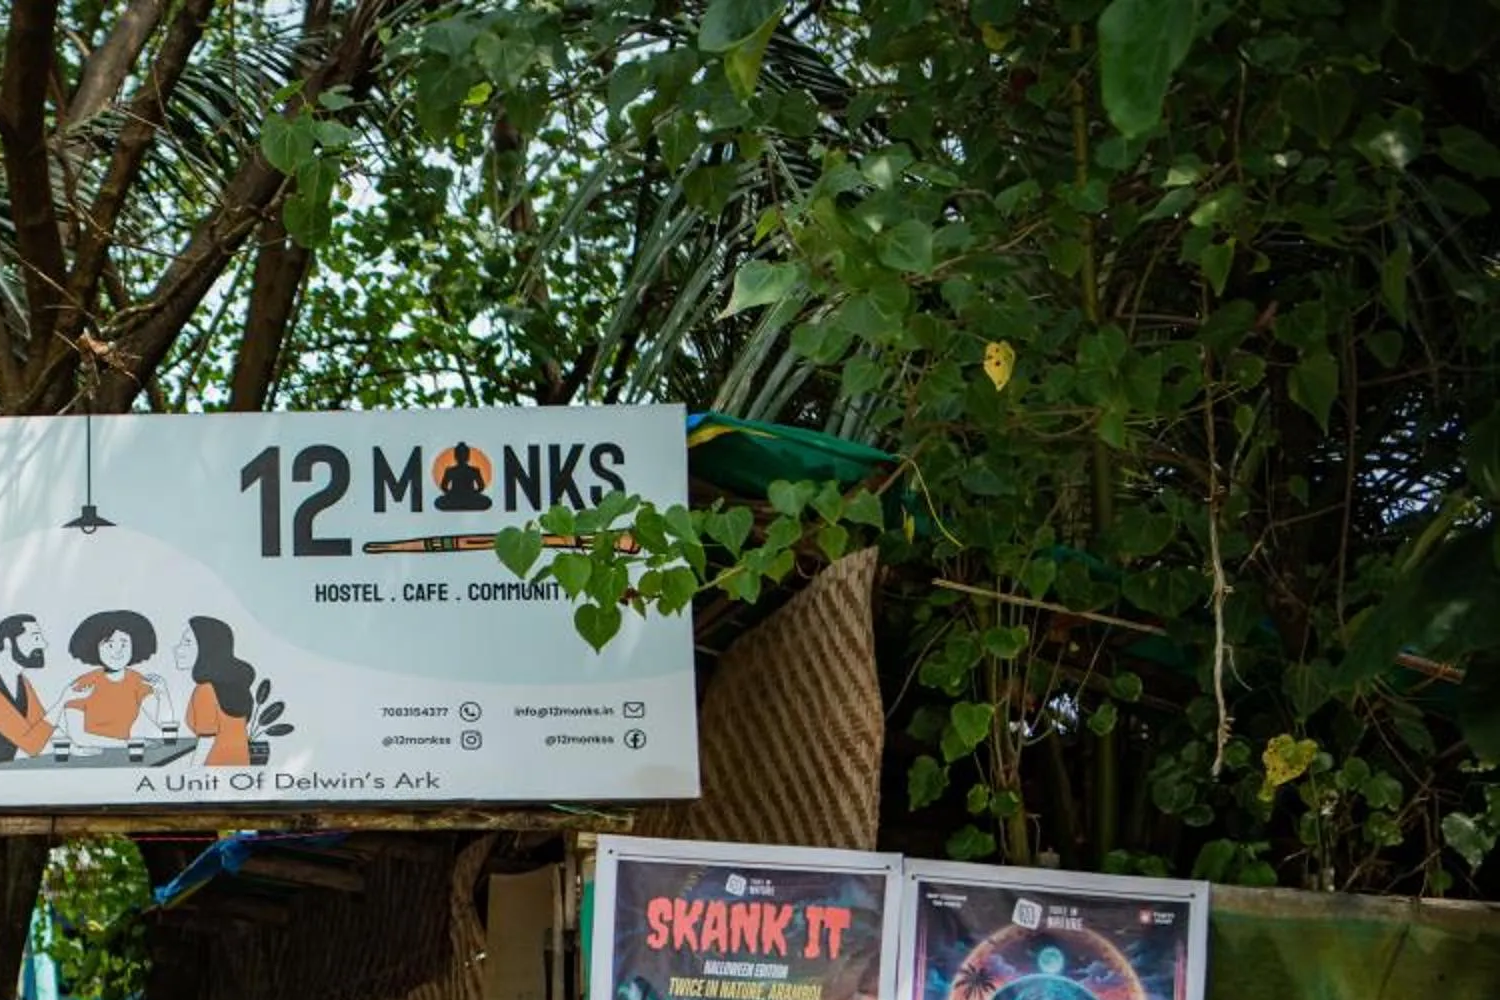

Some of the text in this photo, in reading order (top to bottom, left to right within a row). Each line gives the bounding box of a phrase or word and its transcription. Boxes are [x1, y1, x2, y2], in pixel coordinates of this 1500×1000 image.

[240, 444, 353, 557] 12
[315, 583, 381, 602] HOSTEL
[403, 583, 449, 601] CAFE
[468, 582, 570, 601] COMMUNIT
[514, 706, 615, 718] info@12monks.in
[136, 771, 440, 792] A Unit Of Delwin's Ark
[646, 896, 853, 960] SKANK IT
[703, 959, 754, 977] HALLOWEEN
[669, 977, 706, 997] TWICE
[705, 979, 719, 998] IN
